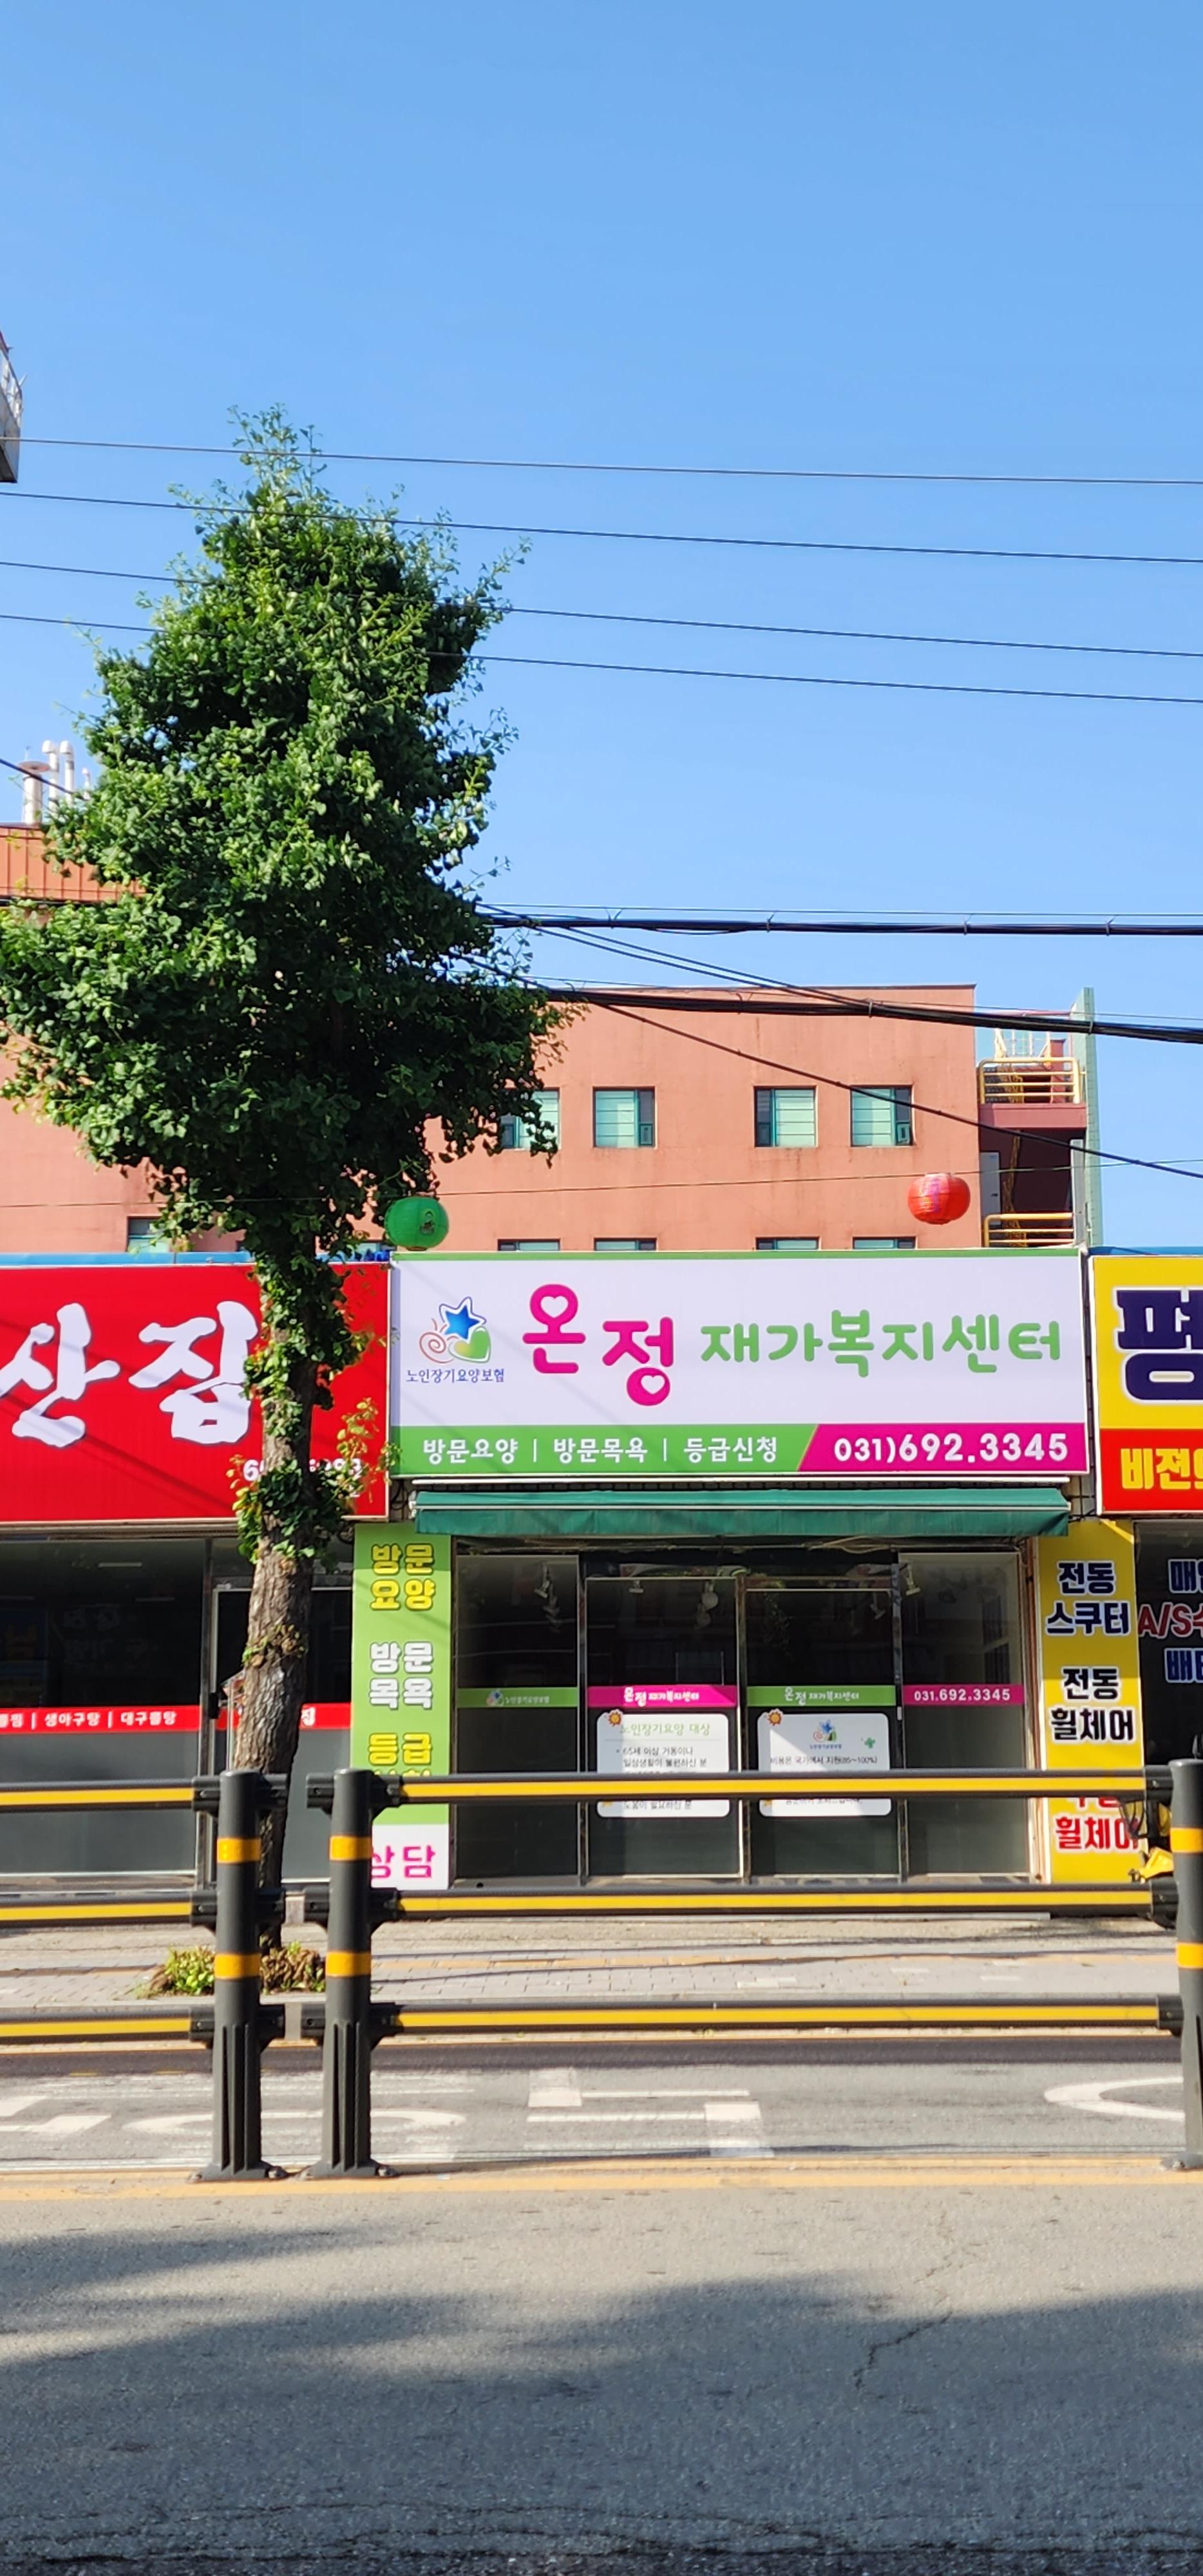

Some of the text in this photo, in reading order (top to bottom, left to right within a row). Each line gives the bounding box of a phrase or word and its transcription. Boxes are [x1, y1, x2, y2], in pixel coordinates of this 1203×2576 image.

[523, 1284, 1061, 1406] 온정 재가복지센터
[406, 1368, 504, 1383] 노인장기요양보험
[424, 1436, 778, 1464] 방문요양 방문목욕 등급신청
[834, 1433, 1068, 1464] 031)692.3345
[372, 1544, 434, 1575] 방문
[1058, 1562, 1115, 1594] 전동
[370, 1579, 435, 1610] 요양
[1047, 1602, 1129, 1634] 스쿠터
[370, 1642, 433, 1674] 방문
[369, 1678, 432, 1710] 목욕
[785, 1687, 806, 1705] 온정
[1063, 1668, 1119, 1700] 전동
[690, 1723, 710, 1736] 대상
[1051, 1709, 1133, 1740] 휠체어
[369, 1732, 431, 1765] 등급
[644, 1747, 659, 1756] 이상
[372, 1845, 436, 1879] 상담
